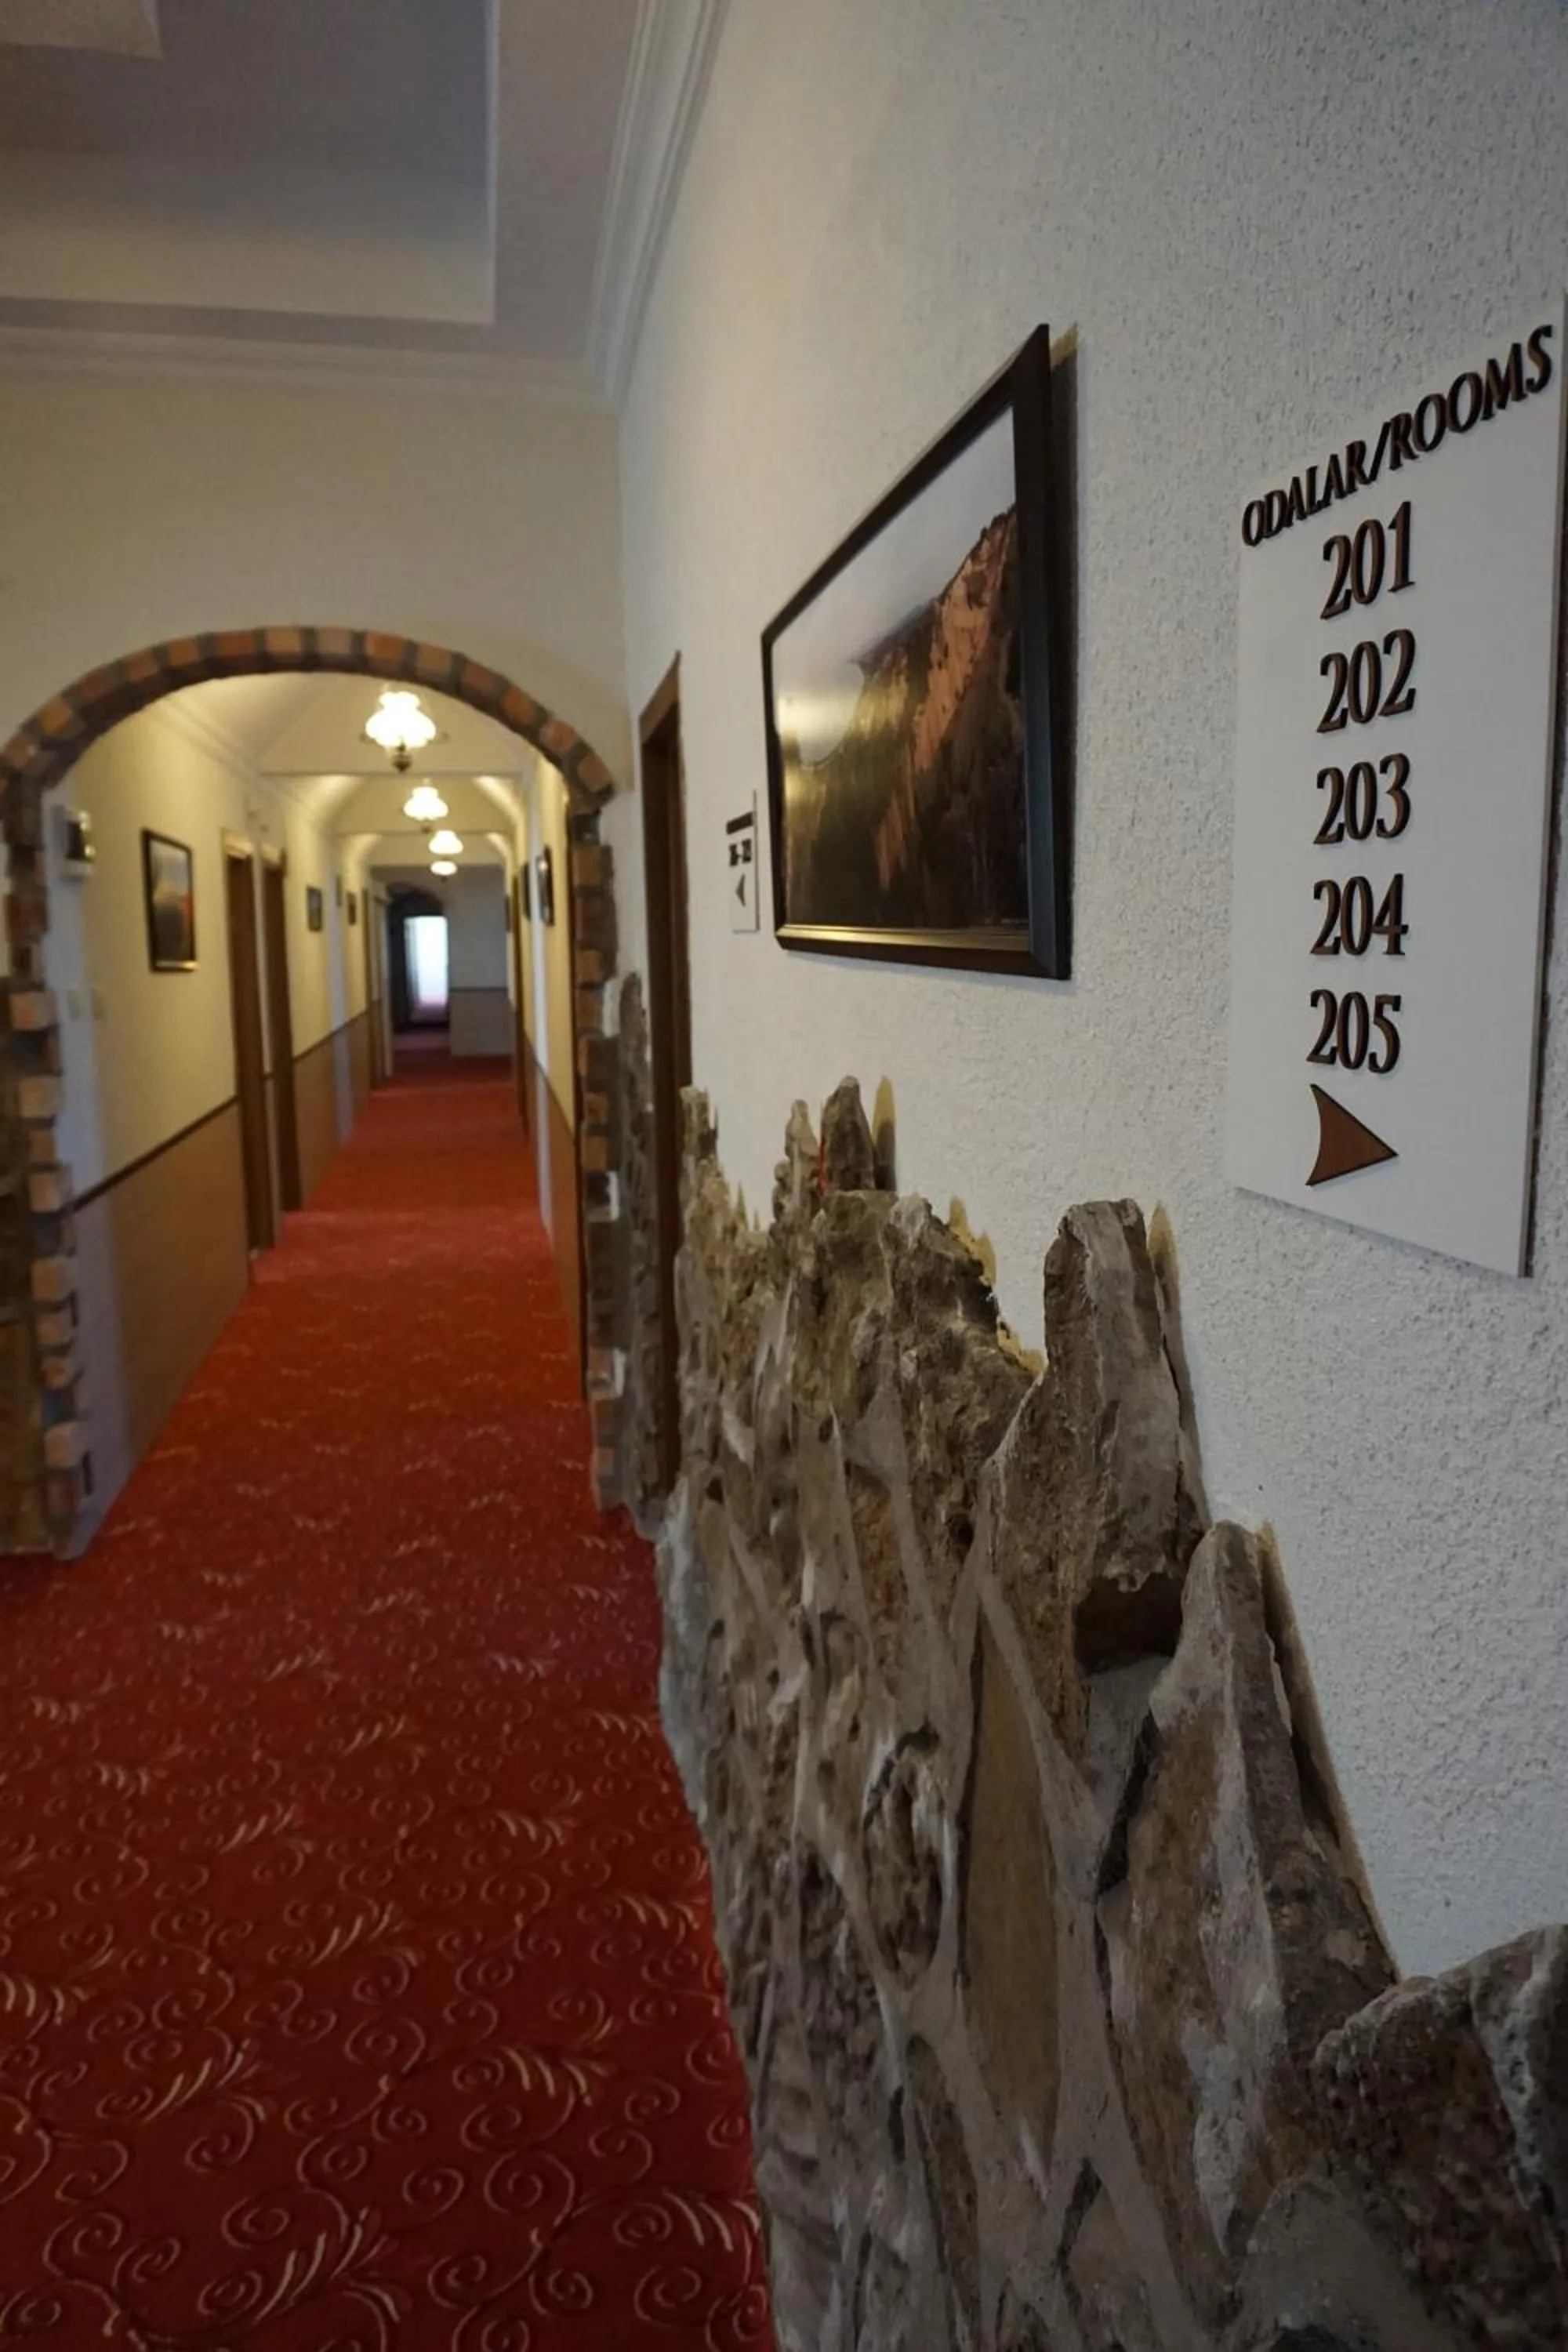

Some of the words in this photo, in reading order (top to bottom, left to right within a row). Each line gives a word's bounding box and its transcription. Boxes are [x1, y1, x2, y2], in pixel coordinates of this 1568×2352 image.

[1241, 324, 1553, 547] ODALAR/ROOMS
[1319, 500, 1415, 620] 201
[1316, 628, 1417, 733] 202
[1312, 753, 1411, 844] 203
[1309, 873, 1409, 956] 204
[1306, 989, 1402, 1074] 205
